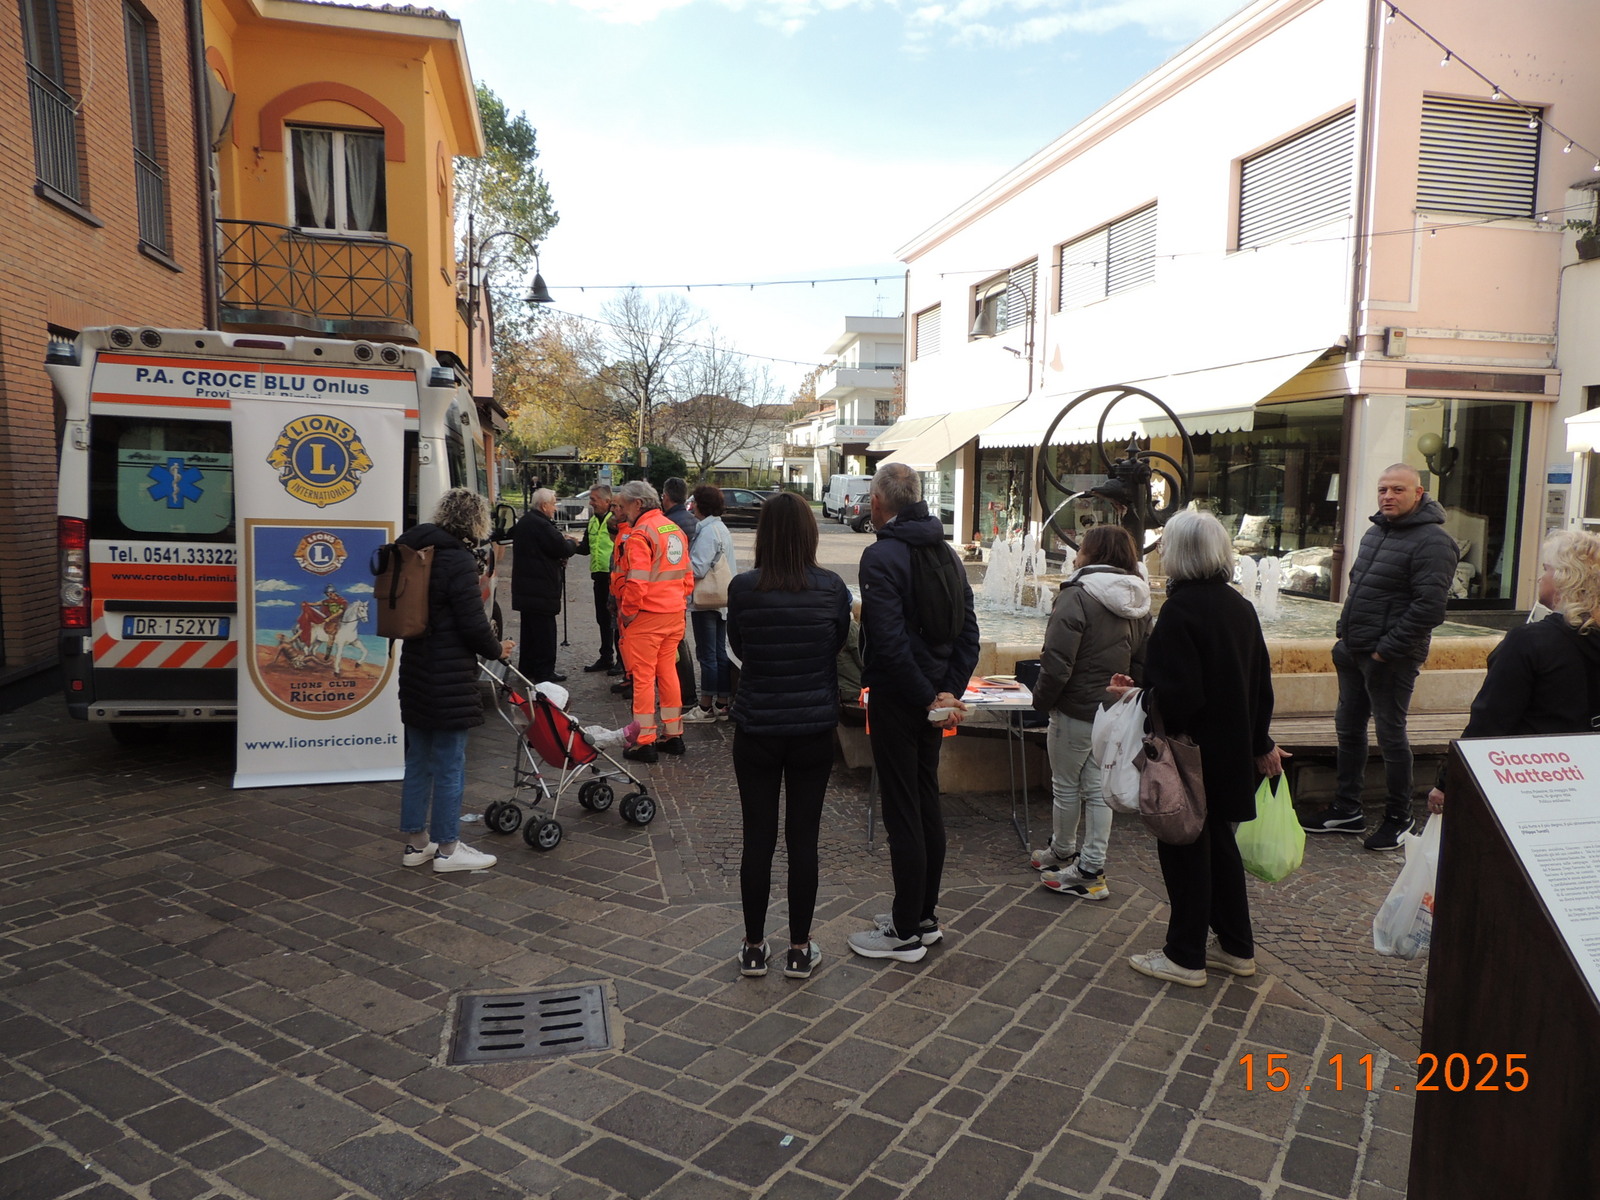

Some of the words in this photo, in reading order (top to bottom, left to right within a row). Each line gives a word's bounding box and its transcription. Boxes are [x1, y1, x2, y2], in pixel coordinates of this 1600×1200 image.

[135, 367, 175, 385] P.A.
[181, 370, 257, 389] CROCE
[263, 375, 306, 392] BLU
[312, 377, 370, 396] Onlus
[290, 418, 351, 440] LIONS
[309, 443, 337, 475] L
[290, 482, 351, 501] INTERNATIONAL
[306, 533, 337, 544] LIONS
[108, 545, 138, 563] Tel.
[313, 545, 330, 563] L
[135, 618, 157, 635] DR
[164, 619, 217, 635] 152XY
[290, 681, 323, 690] LIONS
[328, 680, 357, 688] CLUB
[289, 690, 356, 703] Riccione
[244, 733, 398, 752] www.lionsriccione.it
[1487, 750, 1571, 767] Giacomo
[1492, 765, 1585, 785] Matteotti
